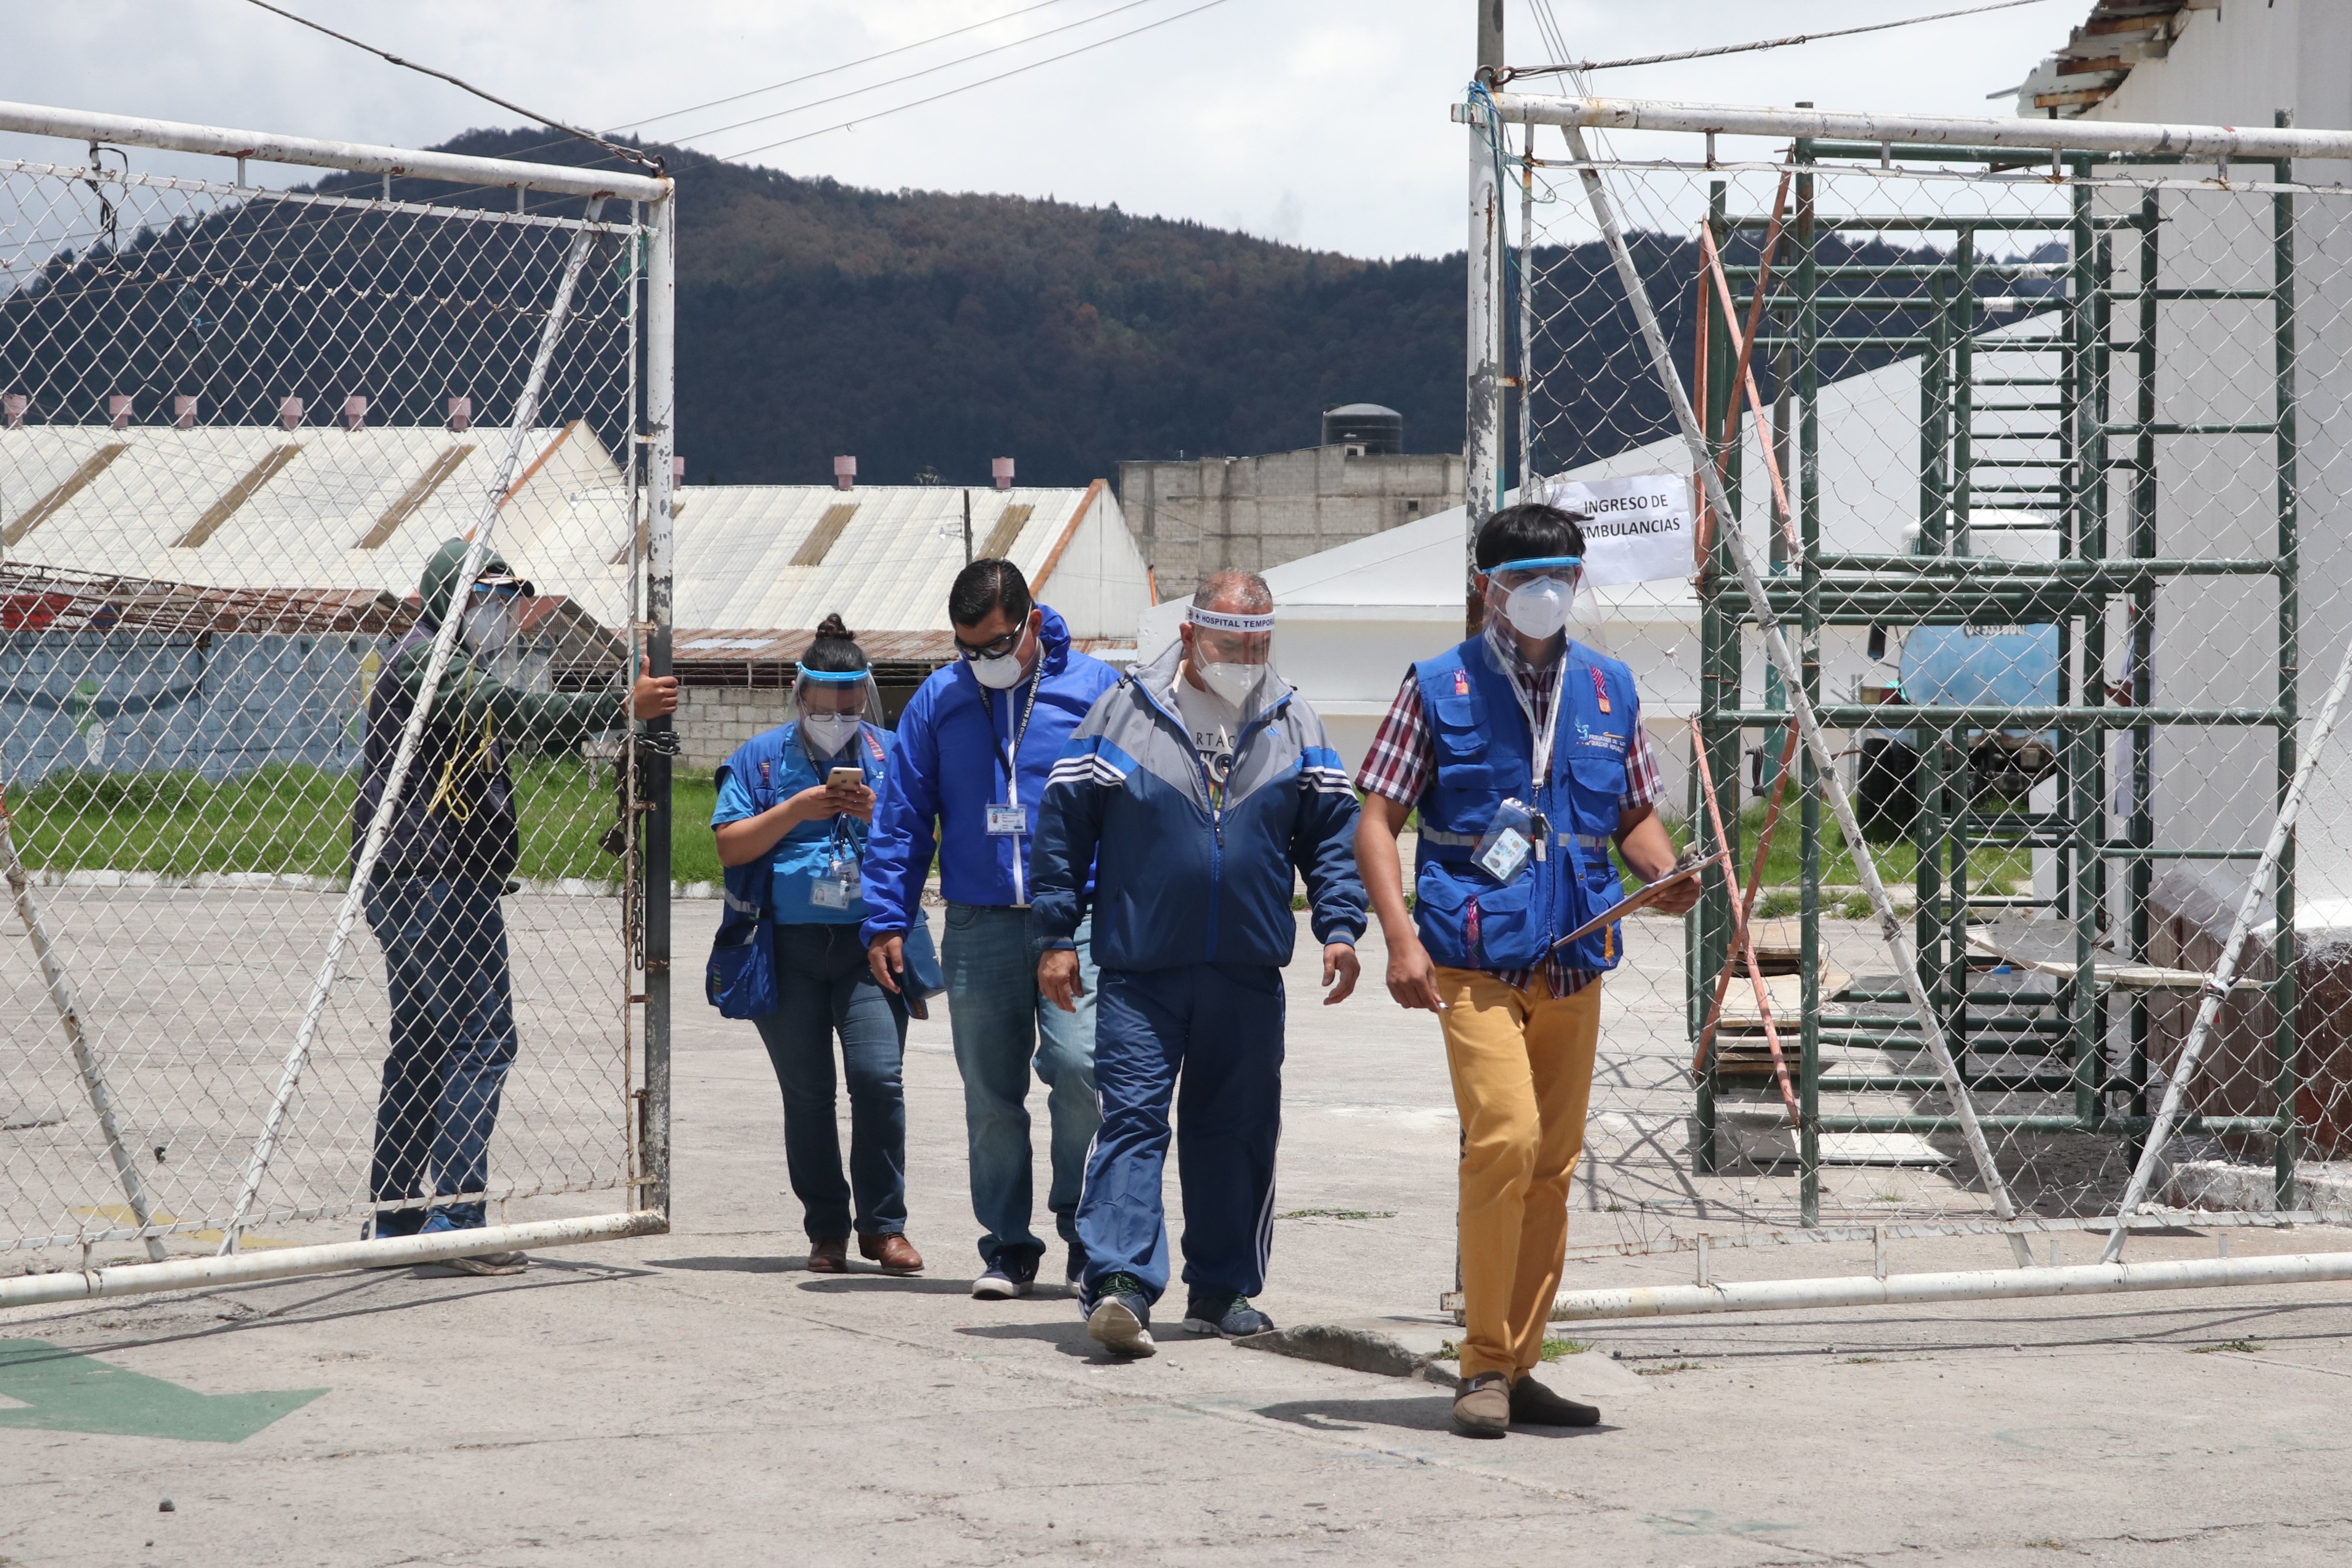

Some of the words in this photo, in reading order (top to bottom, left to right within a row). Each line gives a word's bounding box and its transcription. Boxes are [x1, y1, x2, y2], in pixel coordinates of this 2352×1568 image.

[1585, 496, 1647, 514] INGRESO
[1651, 495, 1668, 507] DE
[1202, 616, 1240, 627] HOSPITAL
[1024, 698, 1033, 717] SALUD
[1022, 718, 1028, 727] DE
[1196, 732, 1236, 748] RTAC
